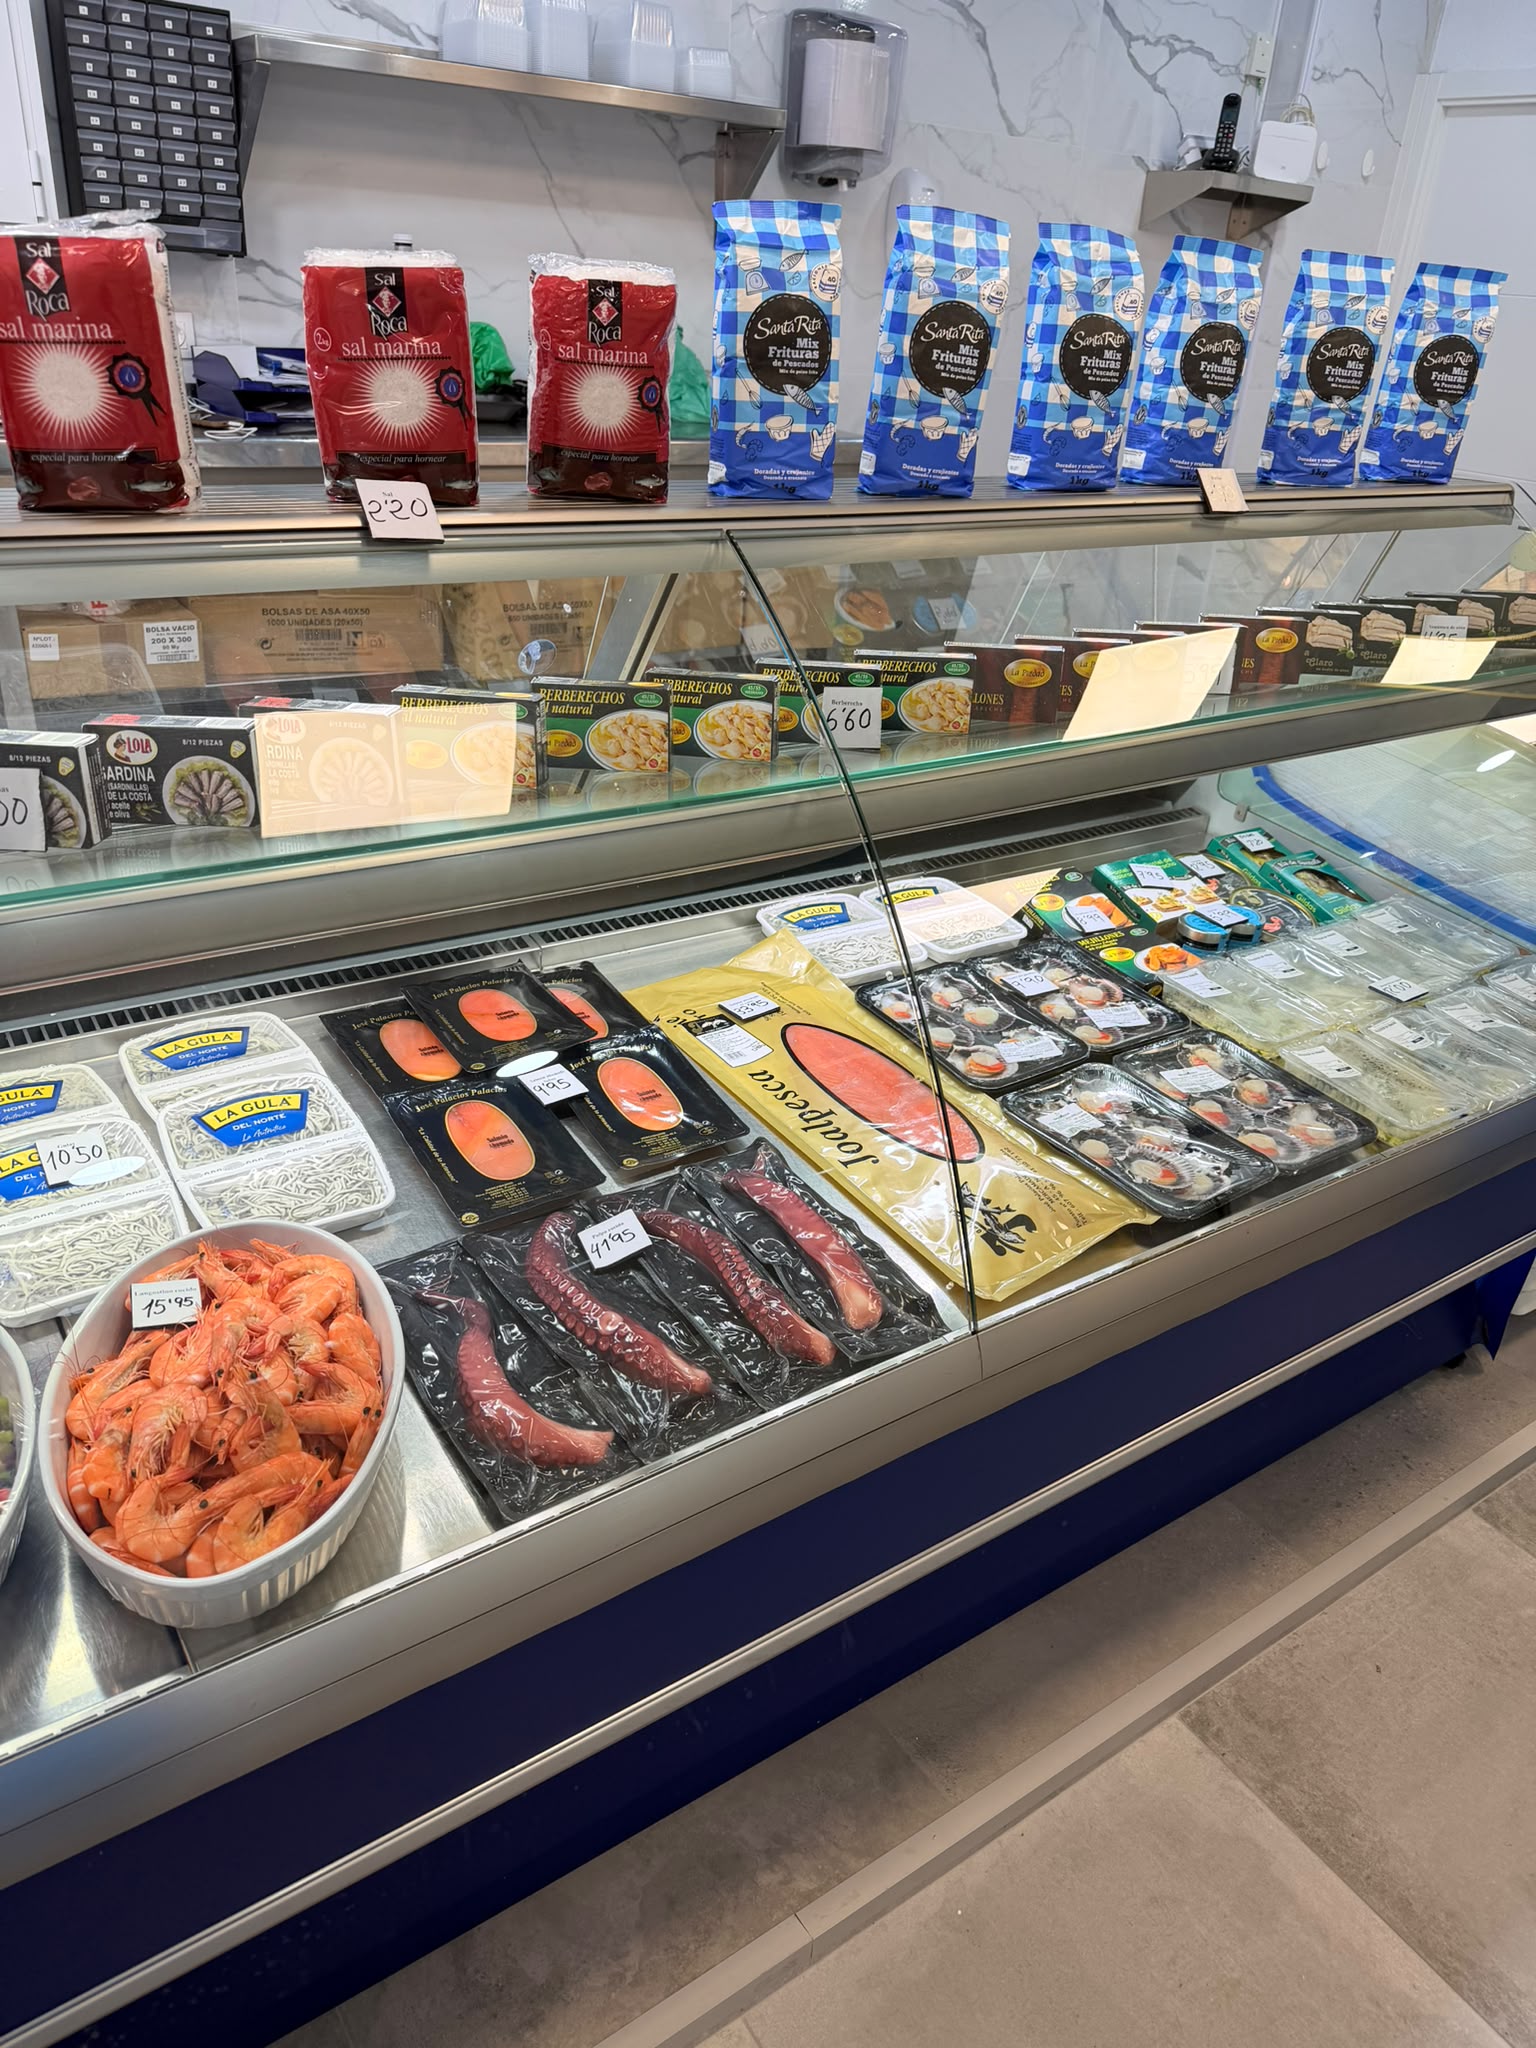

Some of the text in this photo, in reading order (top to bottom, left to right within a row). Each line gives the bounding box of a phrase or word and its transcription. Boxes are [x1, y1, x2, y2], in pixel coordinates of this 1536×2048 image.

[26, 242, 51, 258] Sal
[374, 272, 396, 286] Sal
[596, 286, 616, 298] Sal
[25, 290, 71, 321] Roca
[0, 316, 114, 340] sal marina
[372, 315, 408, 340] Roca
[588, 322, 622, 348] Roca
[754, 316, 822, 340] Santa Rita
[920, 322, 986, 343] Santa Rita
[341, 336, 442, 358] sal marina
[796, 338, 820, 348] Mix
[1070, 330, 1126, 350] Santa Rita
[1190, 338, 1242, 356] Santa Rita
[558, 341, 648, 365] sal marina
[768, 346, 820, 359] Frituras
[931, 348, 978, 367] Frituras
[958, 344, 980, 358] Mix
[1103, 350, 1122, 360] Mix
[1316, 344, 1370, 360] Santa Rita
[1424, 351, 1474, 366] Santa Rita
[772, 359, 819, 368] de Pescados
[934, 362, 976, 376] de Pescados
[1080, 356, 1121, 369] Frituras
[1200, 360, 1236, 375] Frituras
[1221, 356, 1238, 367] Mix
[1346, 360, 1365, 370] Mix
[1324, 365, 1364, 378] Frituras
[1430, 371, 1468, 384] Frituras
[1452, 366, 1470, 376] Mix
[31, 452, 66, 464] especial
[68, 454, 90, 464] para
[359, 454, 447, 464] especial para hornear
[560, 449, 640, 462] especial para hornear
[262, 608, 302, 616] BOLSAS
[304, 608, 318, 616] DE
[320, 608, 341, 616] ASA
[146, 624, 196, 634] BOLSA VACIO
[288, 618, 332, 626] UNIDADES
[168, 636, 176, 644] X
[176, 636, 192, 644] 300
[540, 688, 626, 704] BERBERECHOS
[400, 696, 489, 716] BERBERECHOS
[551, 703, 594, 716] natural
[278, 718, 302, 734] LOLA
[414, 712, 458, 726] natural
[826, 707, 872, 732] 6'60
[126, 736, 152, 754] LOLA
[198, 738, 224, 746] PIEZAS
[25, 755, 52, 763] PIEZAS
[108, 792, 153, 802] DE LA COSTA
[1136, 870, 1164, 880] 7'95
[1296, 893, 1317, 913] Gildas
[790, 906, 837, 920] LA GULA
[1078, 930, 1125, 947] MEJILLONES
[432, 976, 515, 1000] José Palacios Palacios
[550, 977, 584, 987] Palacios
[352, 1011, 402, 1031] José Palacios
[162, 1032, 233, 1054] LA GULA
[178, 1045, 228, 1060] DEL NORTE
[568, 1060, 586, 1072] José
[532, 1078, 572, 1097] 9'95
[2, 1101, 37, 1113] NORTE
[414, 1086, 508, 1114] José Palacios Palacios
[214, 1096, 292, 1123] LA GULA
[232, 1113, 287, 1132] DEL NORTE
[747, 1069, 880, 1170] Joalpesca
[242, 1132, 252, 1142] La
[46, 1144, 102, 1170] 10'50
[0, 1158, 24, 1173] LA
[14, 1172, 37, 1182] DEL
[590, 1228, 636, 1259] 41'95
[142, 1296, 194, 1318] 15'95
